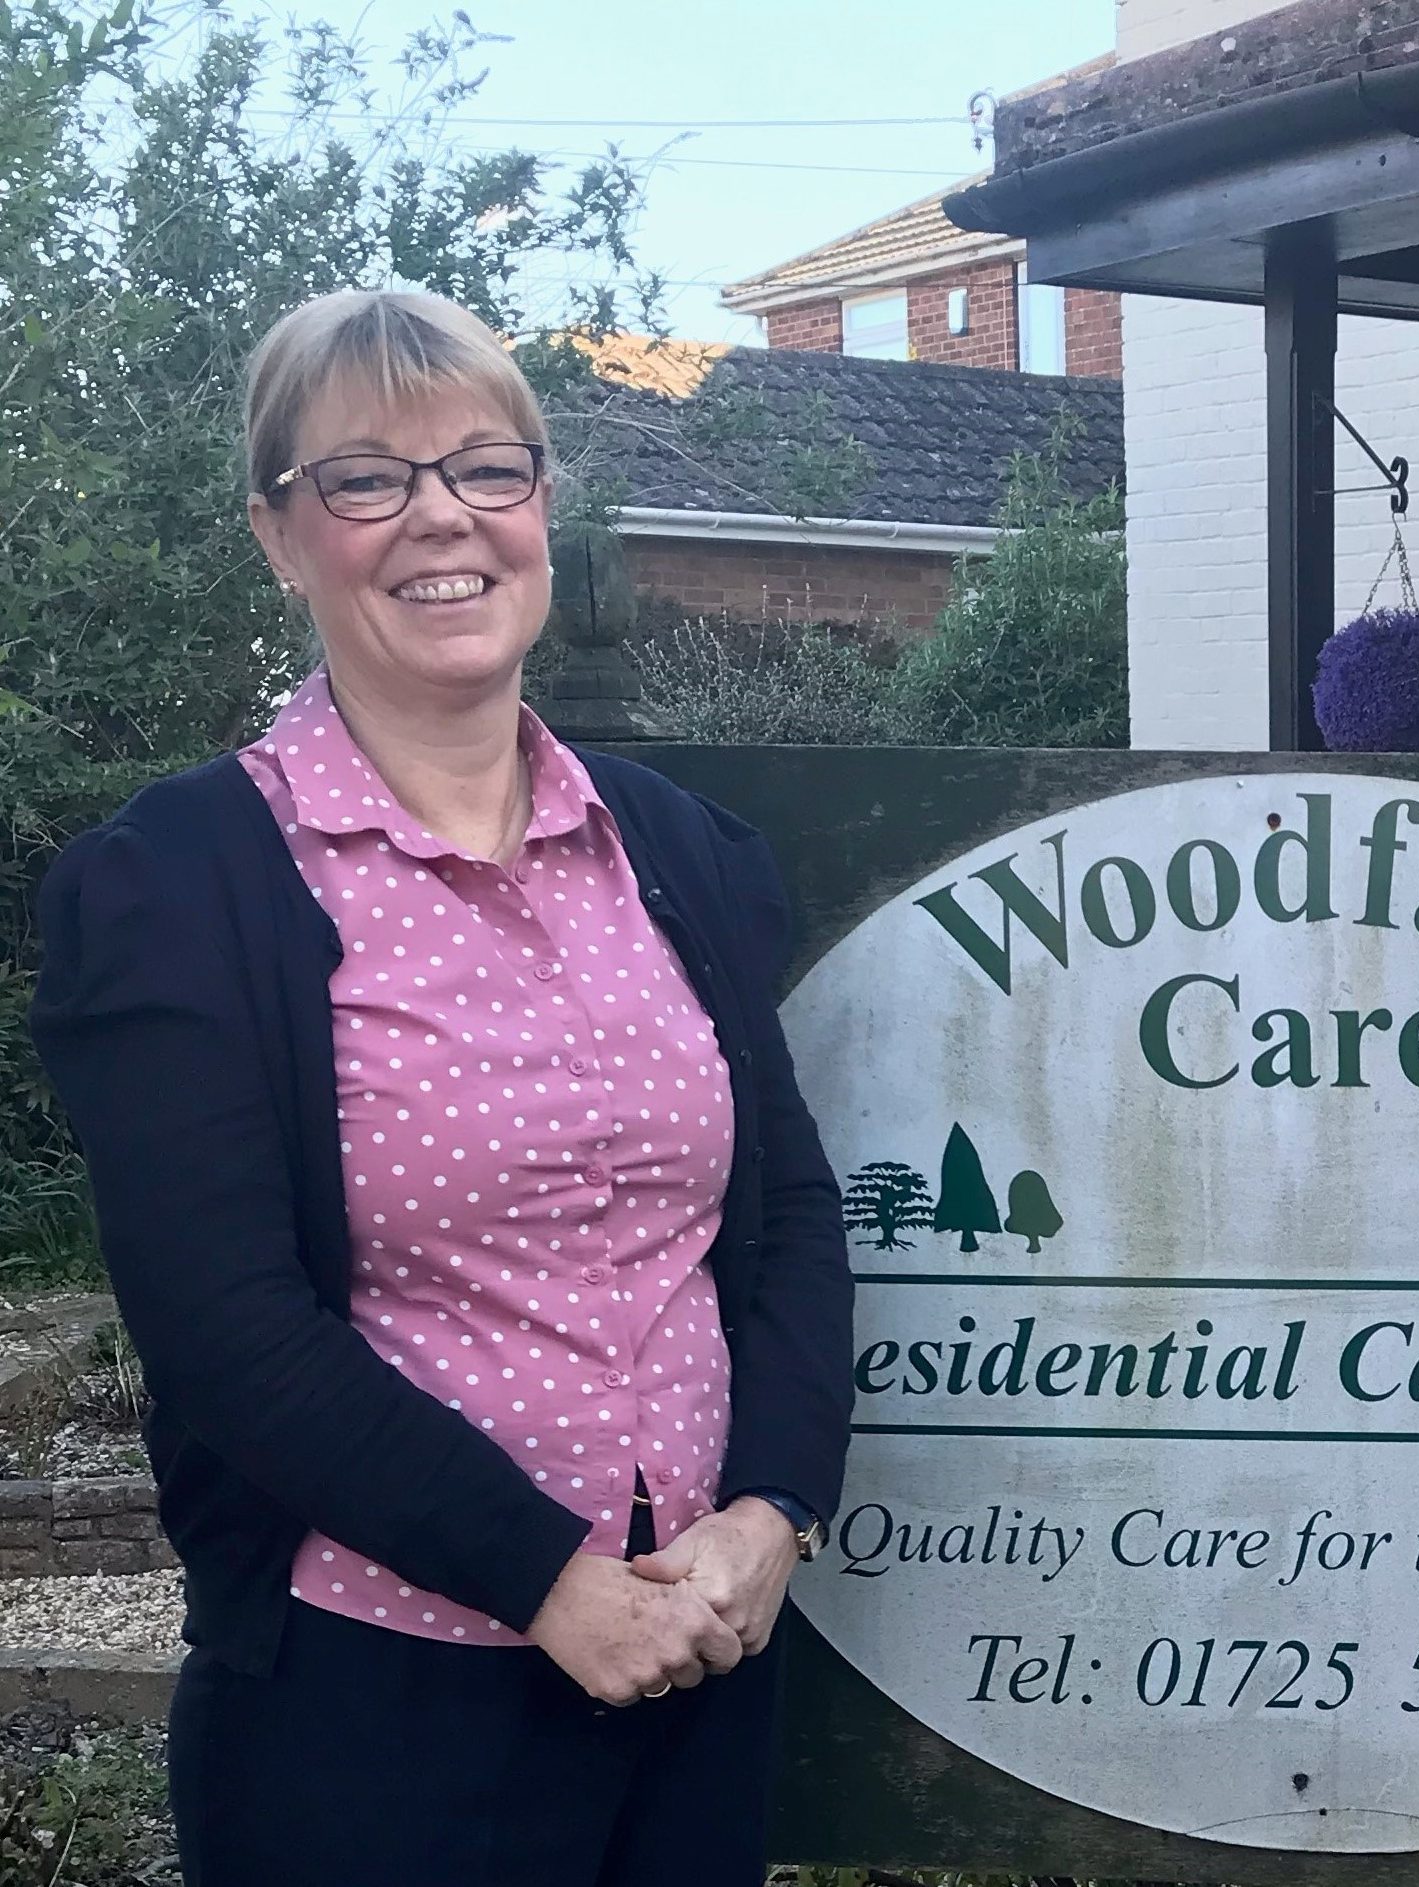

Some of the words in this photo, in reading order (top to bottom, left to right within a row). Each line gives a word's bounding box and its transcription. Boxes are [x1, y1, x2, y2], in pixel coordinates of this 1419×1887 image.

[853, 1315, 1307, 1401] esidential
[1110, 1507, 1271, 1570] Care
[1277, 1509, 1393, 1587] for
[965, 1634, 1101, 1706] Tel:
[1136, 1637, 1360, 1711] 01725
